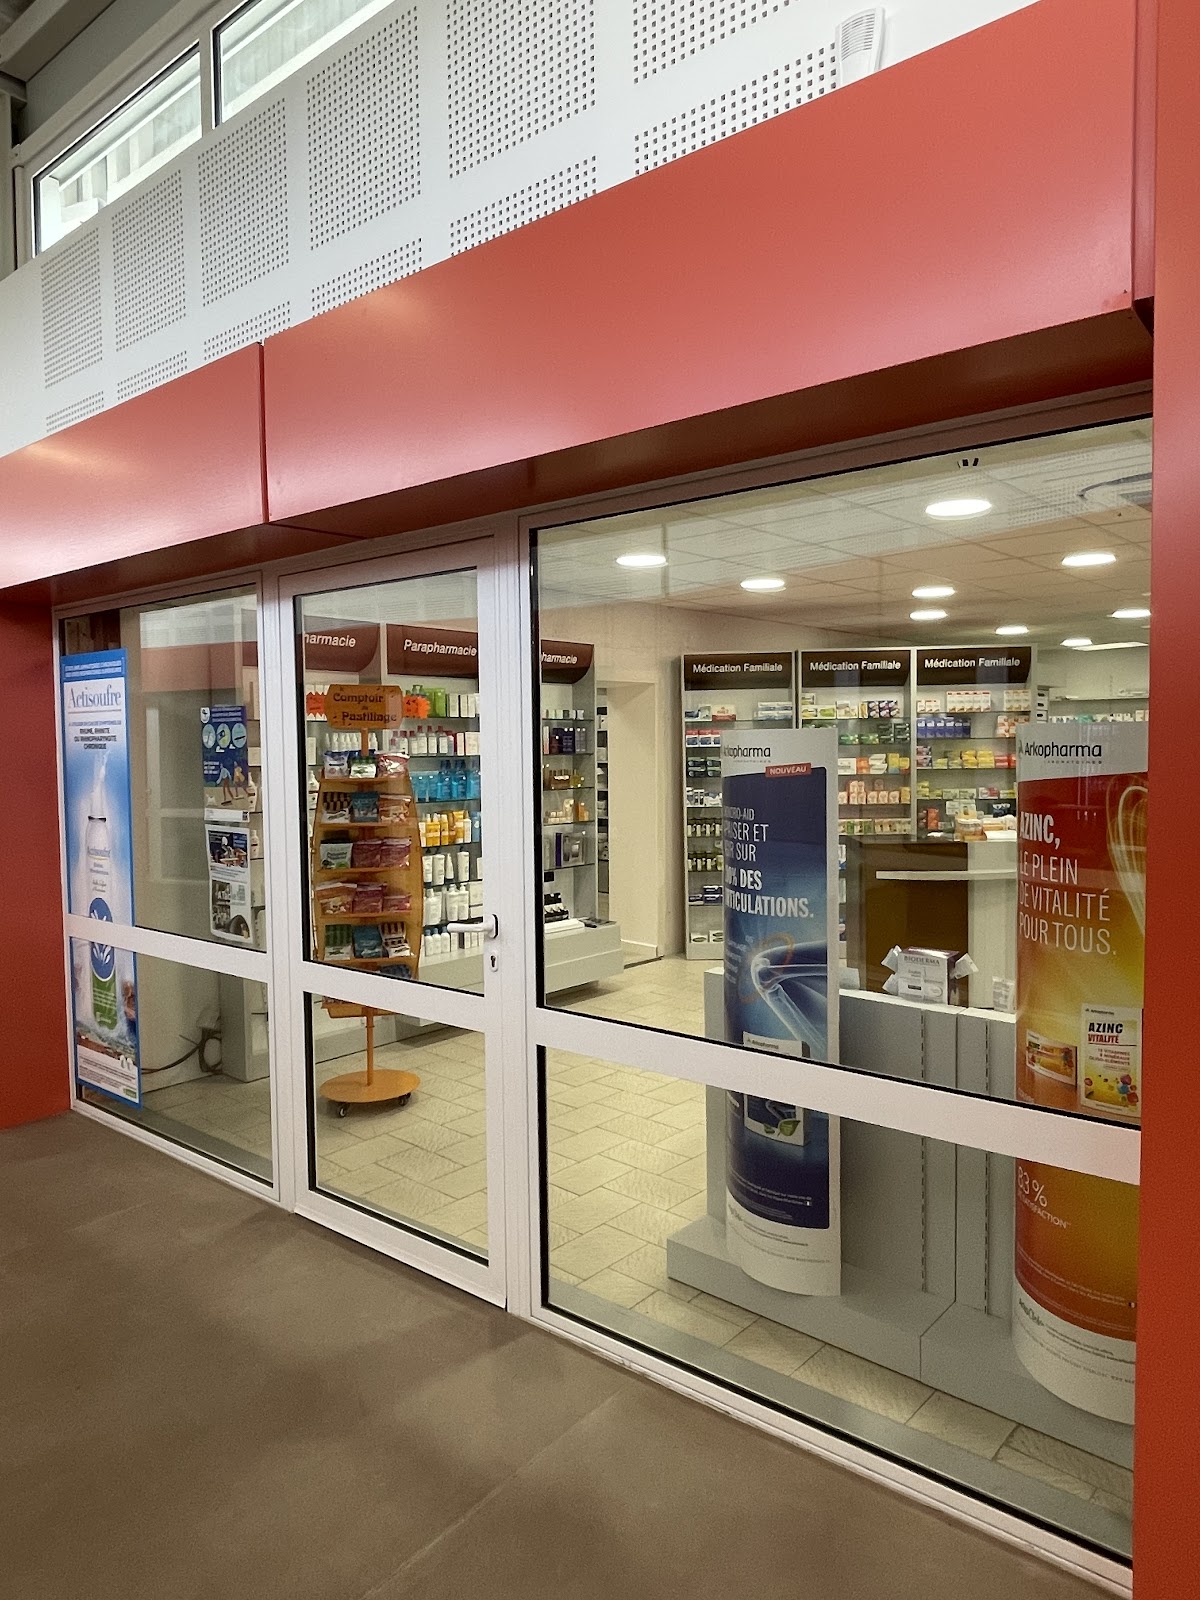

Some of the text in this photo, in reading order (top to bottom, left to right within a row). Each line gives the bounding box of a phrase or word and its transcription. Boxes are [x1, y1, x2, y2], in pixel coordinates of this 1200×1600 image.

[403, 639, 477, 656] Parapharmacie
[692, 662, 783, 673] Médication Familiale
[809, 660, 901, 671] Médication Familiale
[924, 657, 1021, 669] Médication Familiale
[68, 684, 122, 708] Actisoufre
[332, 692, 385, 705] Comptoir
[1024, 741, 1102, 758] Arkopharma
[769, 766, 807, 775] NOUVEAU
[753, 823, 769, 842] ET
[1019, 811, 1061, 850] AZINC,
[735, 842, 757, 862] SUR
[1032, 853, 1078, 885] PLEIN
[739, 868, 763, 891] DES
[1031, 887, 1111, 922] VITALITÉ
[1018, 911, 1117, 956] POUR TOUS.
[1088, 1022, 1124, 1034] AZINC
[1031, 1179, 1048, 1208] %
